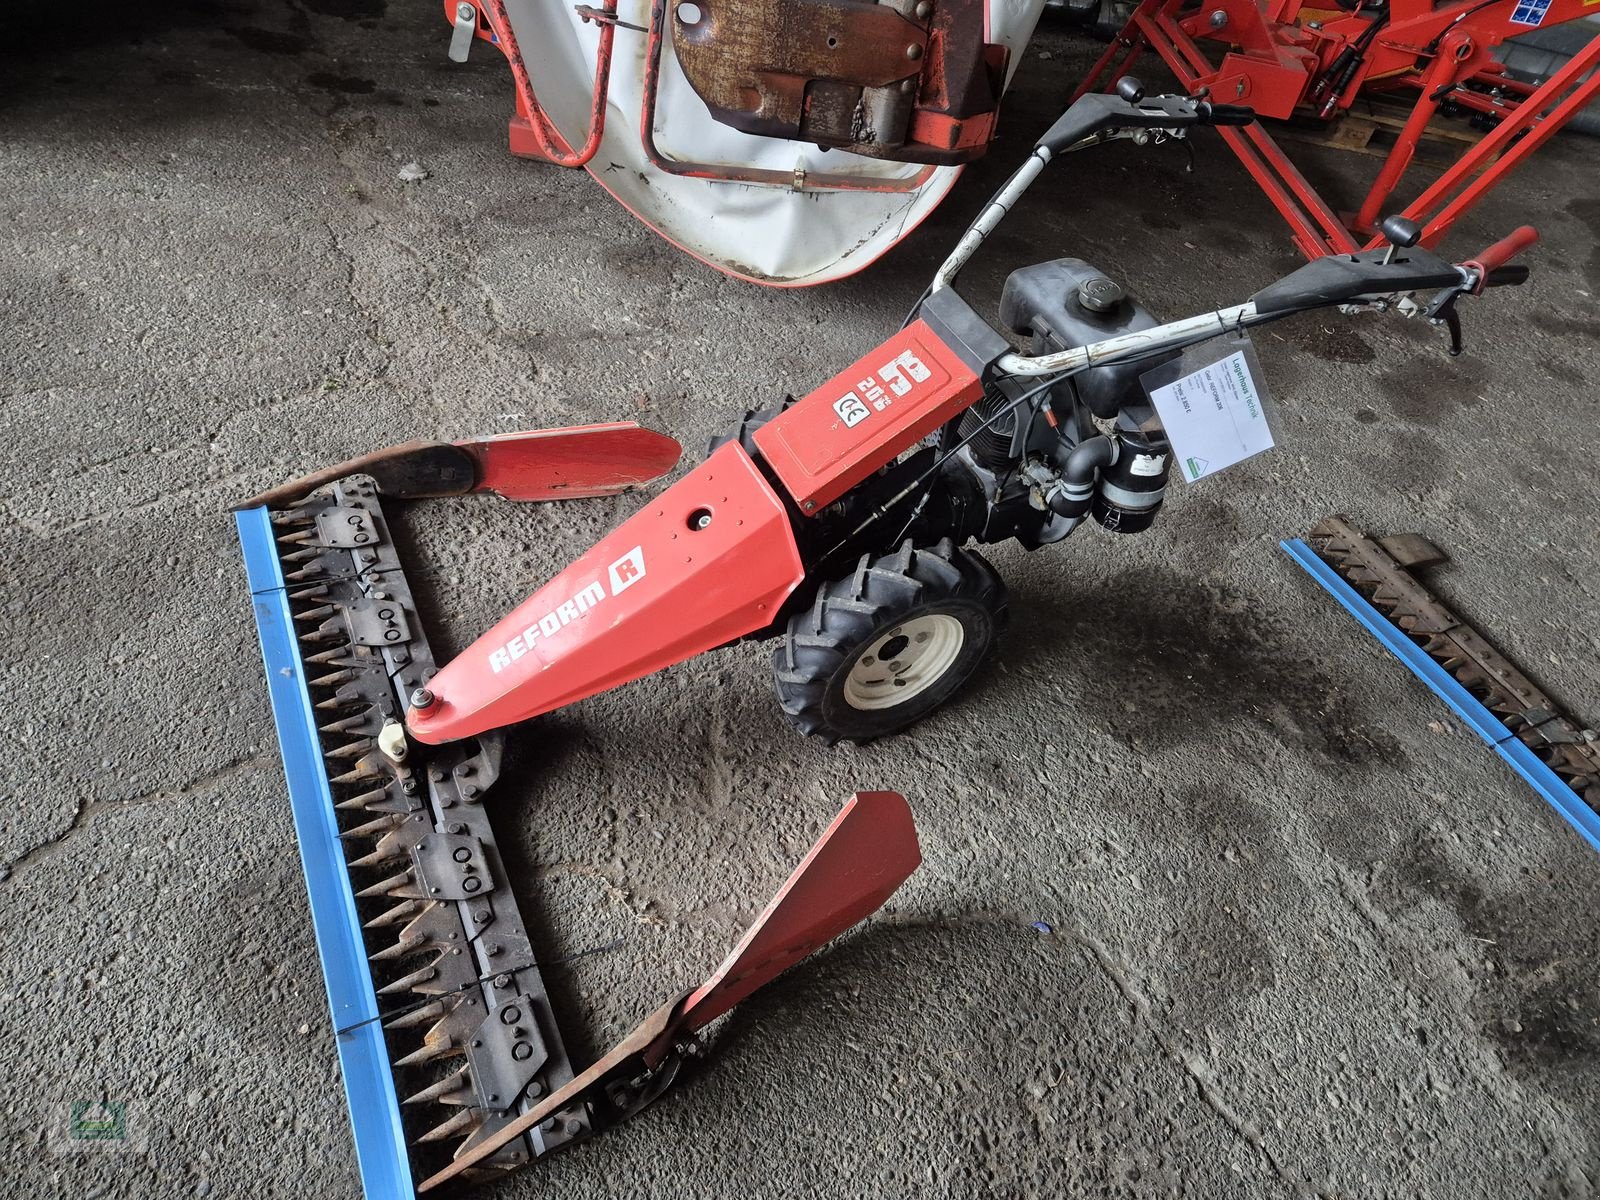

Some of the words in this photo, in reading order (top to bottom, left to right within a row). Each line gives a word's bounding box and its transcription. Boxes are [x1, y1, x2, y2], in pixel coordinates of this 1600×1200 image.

[1209, 381, 1221, 402] REFORM
[1232, 358, 1249, 395] Lagerhaus
[1245, 394, 1258, 419] Technik
[488, 580, 606, 674] REFORM
[615, 558, 639, 584] R
